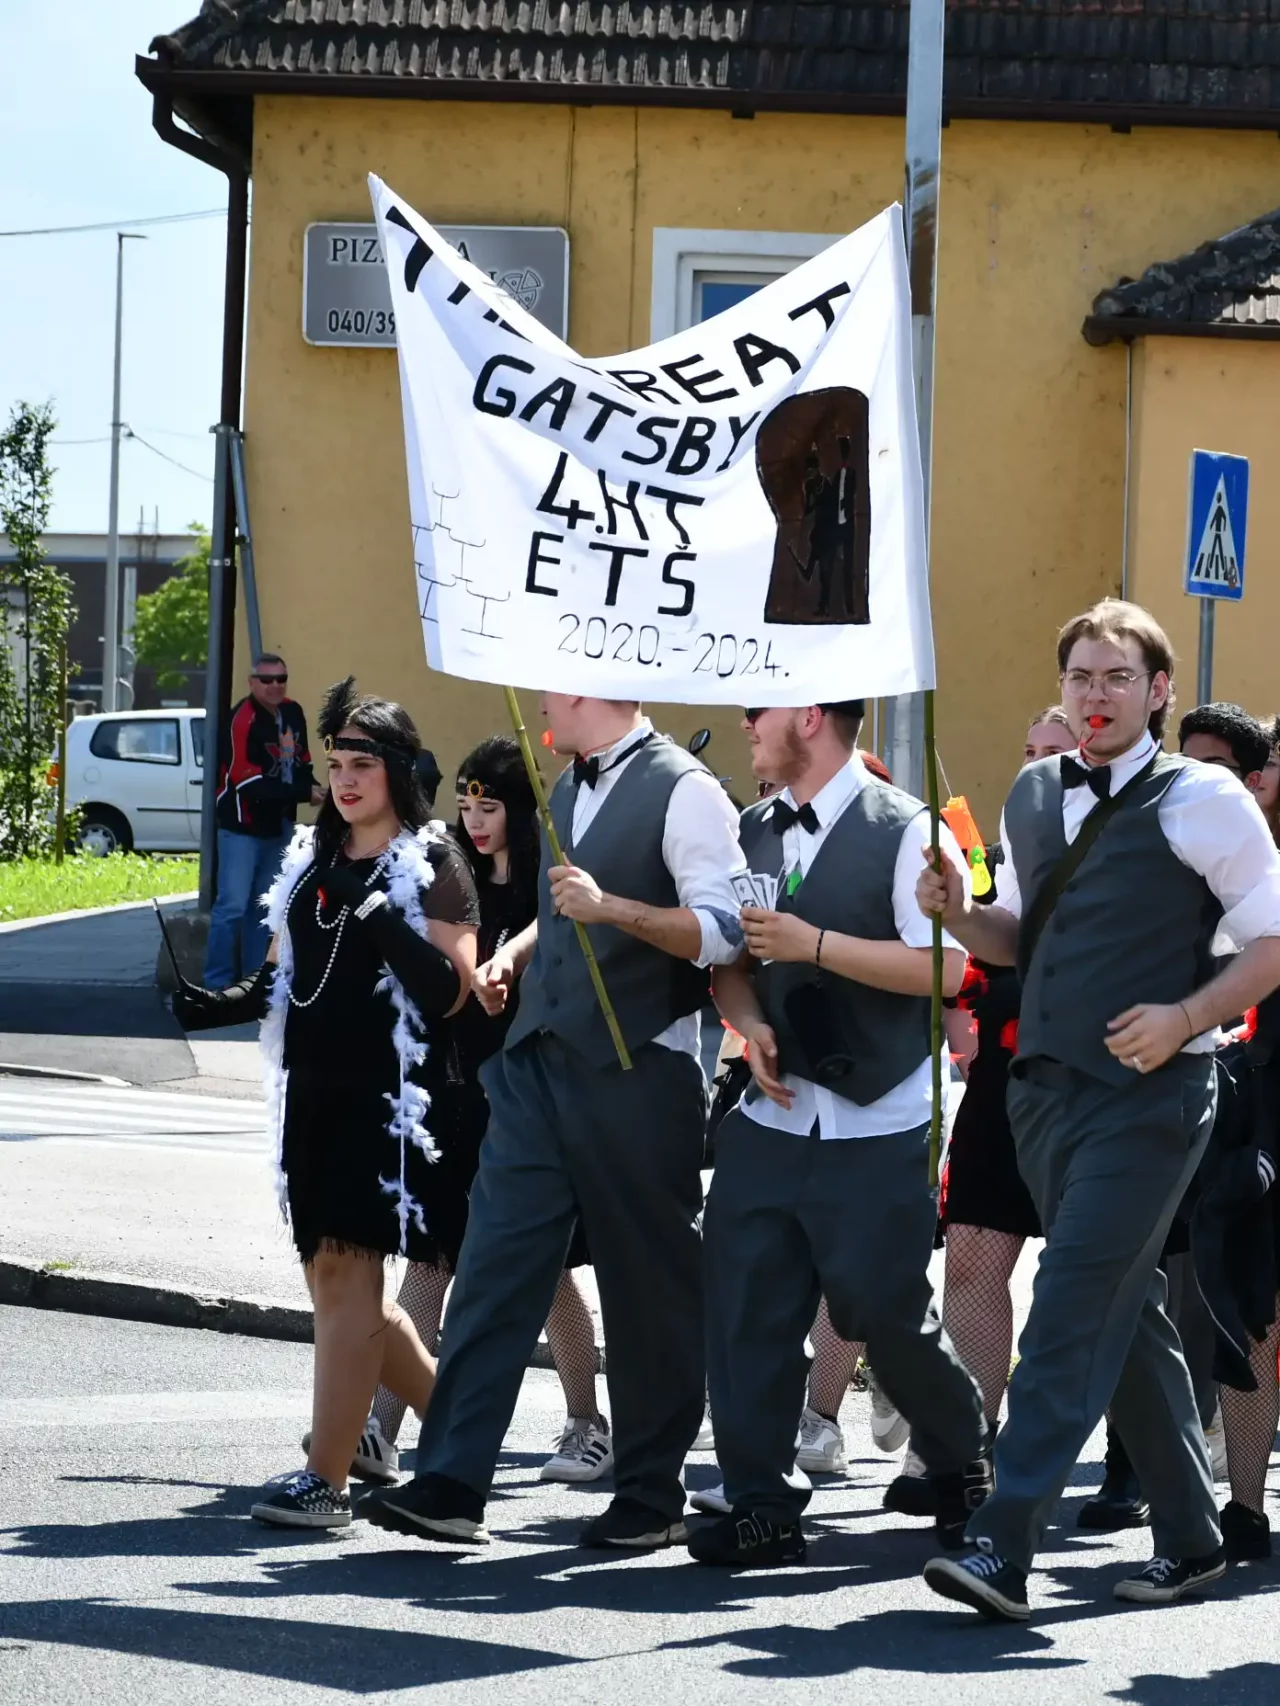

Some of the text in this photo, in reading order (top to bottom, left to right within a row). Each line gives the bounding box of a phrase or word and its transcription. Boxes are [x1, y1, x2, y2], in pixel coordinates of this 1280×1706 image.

[568, 282, 851, 405] REAT
[473, 354, 762, 475] GATSBY
[536, 451, 705, 545] 4.HT
